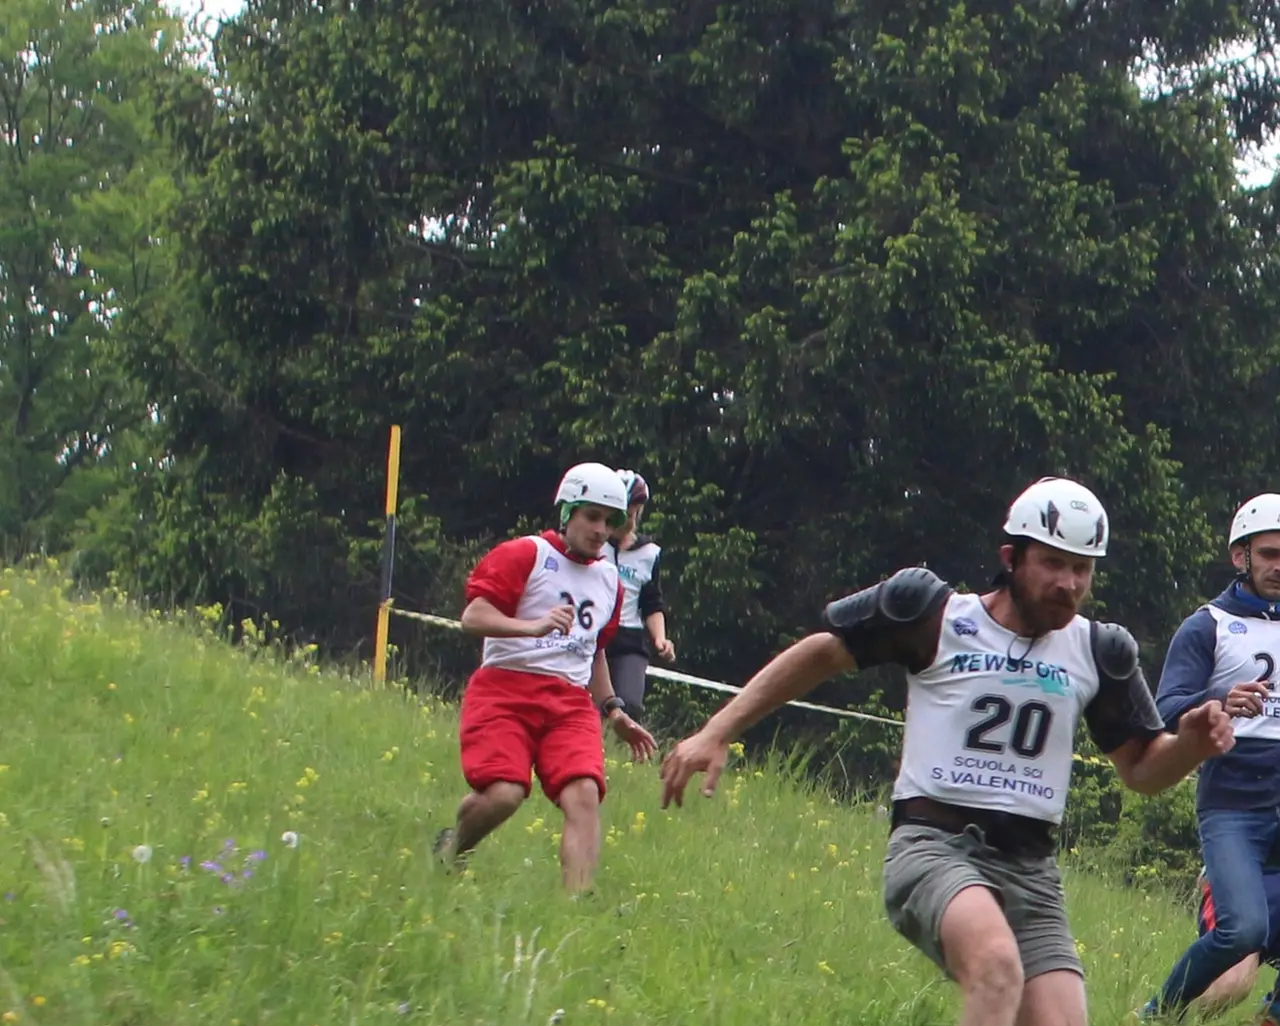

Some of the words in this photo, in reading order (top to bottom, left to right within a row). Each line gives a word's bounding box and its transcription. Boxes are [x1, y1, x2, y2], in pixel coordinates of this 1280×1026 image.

[950, 653, 1070, 687] NEWSPORT
[963, 693, 1054, 760] 20
[931, 767, 1054, 800] S.VALENTINO
[953, 756, 1016, 774] SCUOLA
[1022, 766, 1043, 779] SCI
